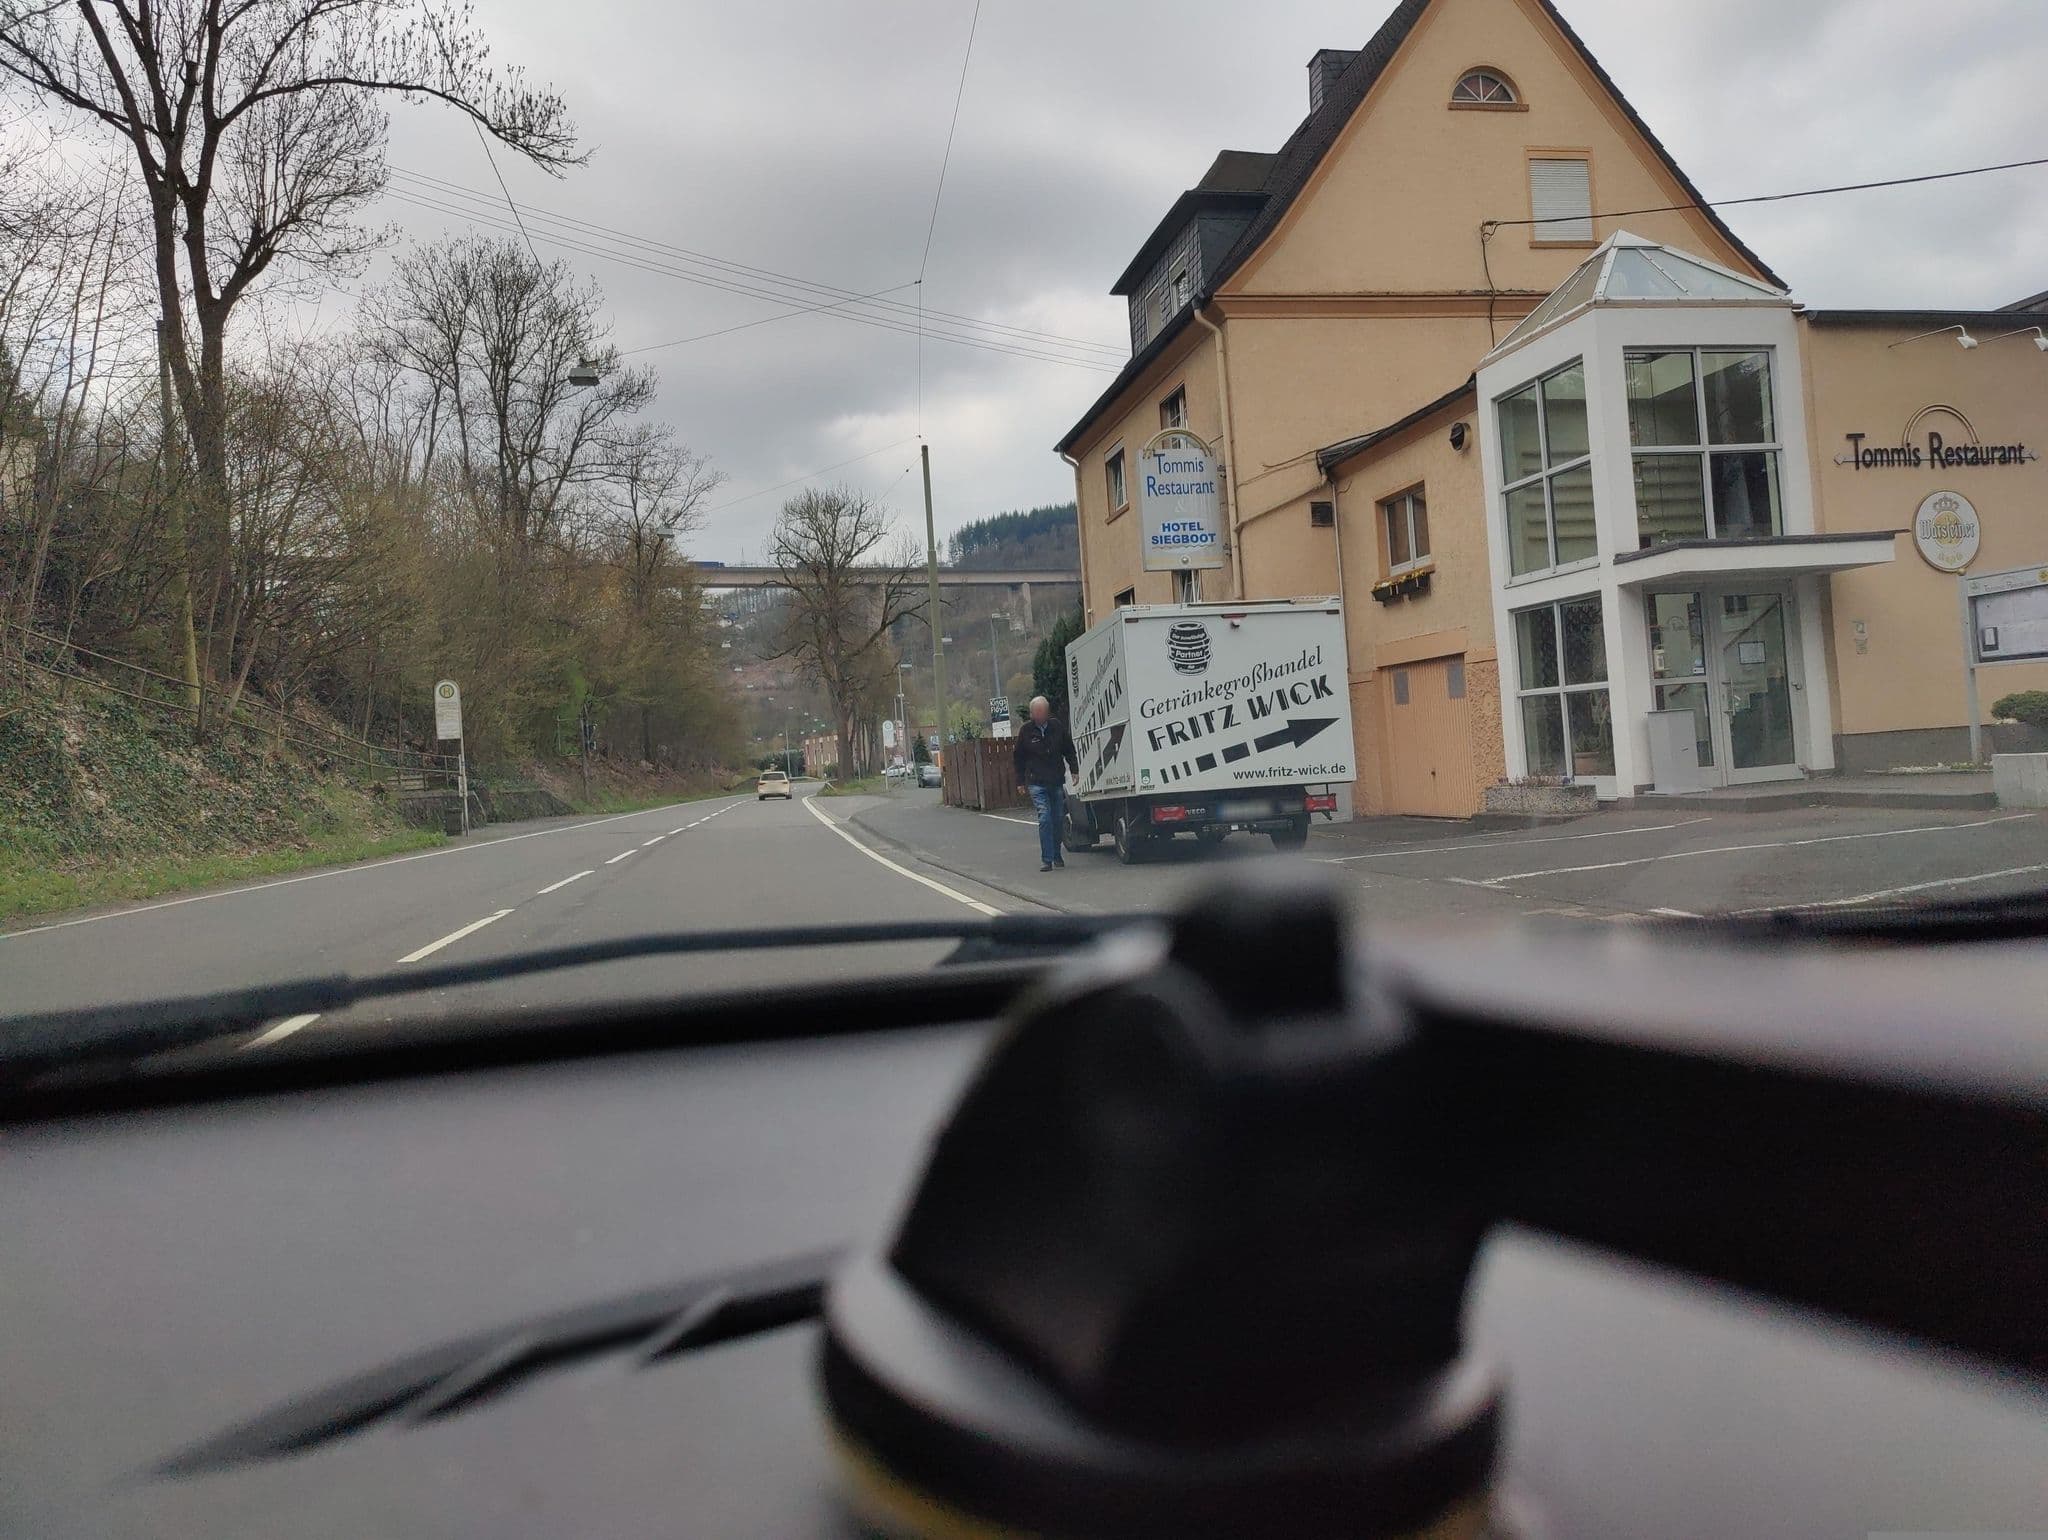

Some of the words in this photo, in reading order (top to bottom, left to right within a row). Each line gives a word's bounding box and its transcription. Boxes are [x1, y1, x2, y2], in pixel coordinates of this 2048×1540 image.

[1846, 433, 1921, 471] Tommis
[1928, 431, 2025, 469] Restaurant
[1153, 453, 1204, 475] Tommis
[1146, 476, 1215, 497] Restaurant
[1162, 521, 1204, 533] HOTEL
[1919, 519, 1975, 540] Warsteiner
[1151, 533, 1216, 545] SIEGBOOT
[1176, 649, 1203, 659] Partner
[1140, 645, 1323, 719] Getränkegroßhandel
[1077, 711, 1099, 766] FRITZ
[1097, 667, 1122, 728] WICK
[1147, 704, 1241, 752] FRITZ
[1246, 674, 1334, 720] WICK
[1233, 762, 1346, 780] www.fritz-wick.de
